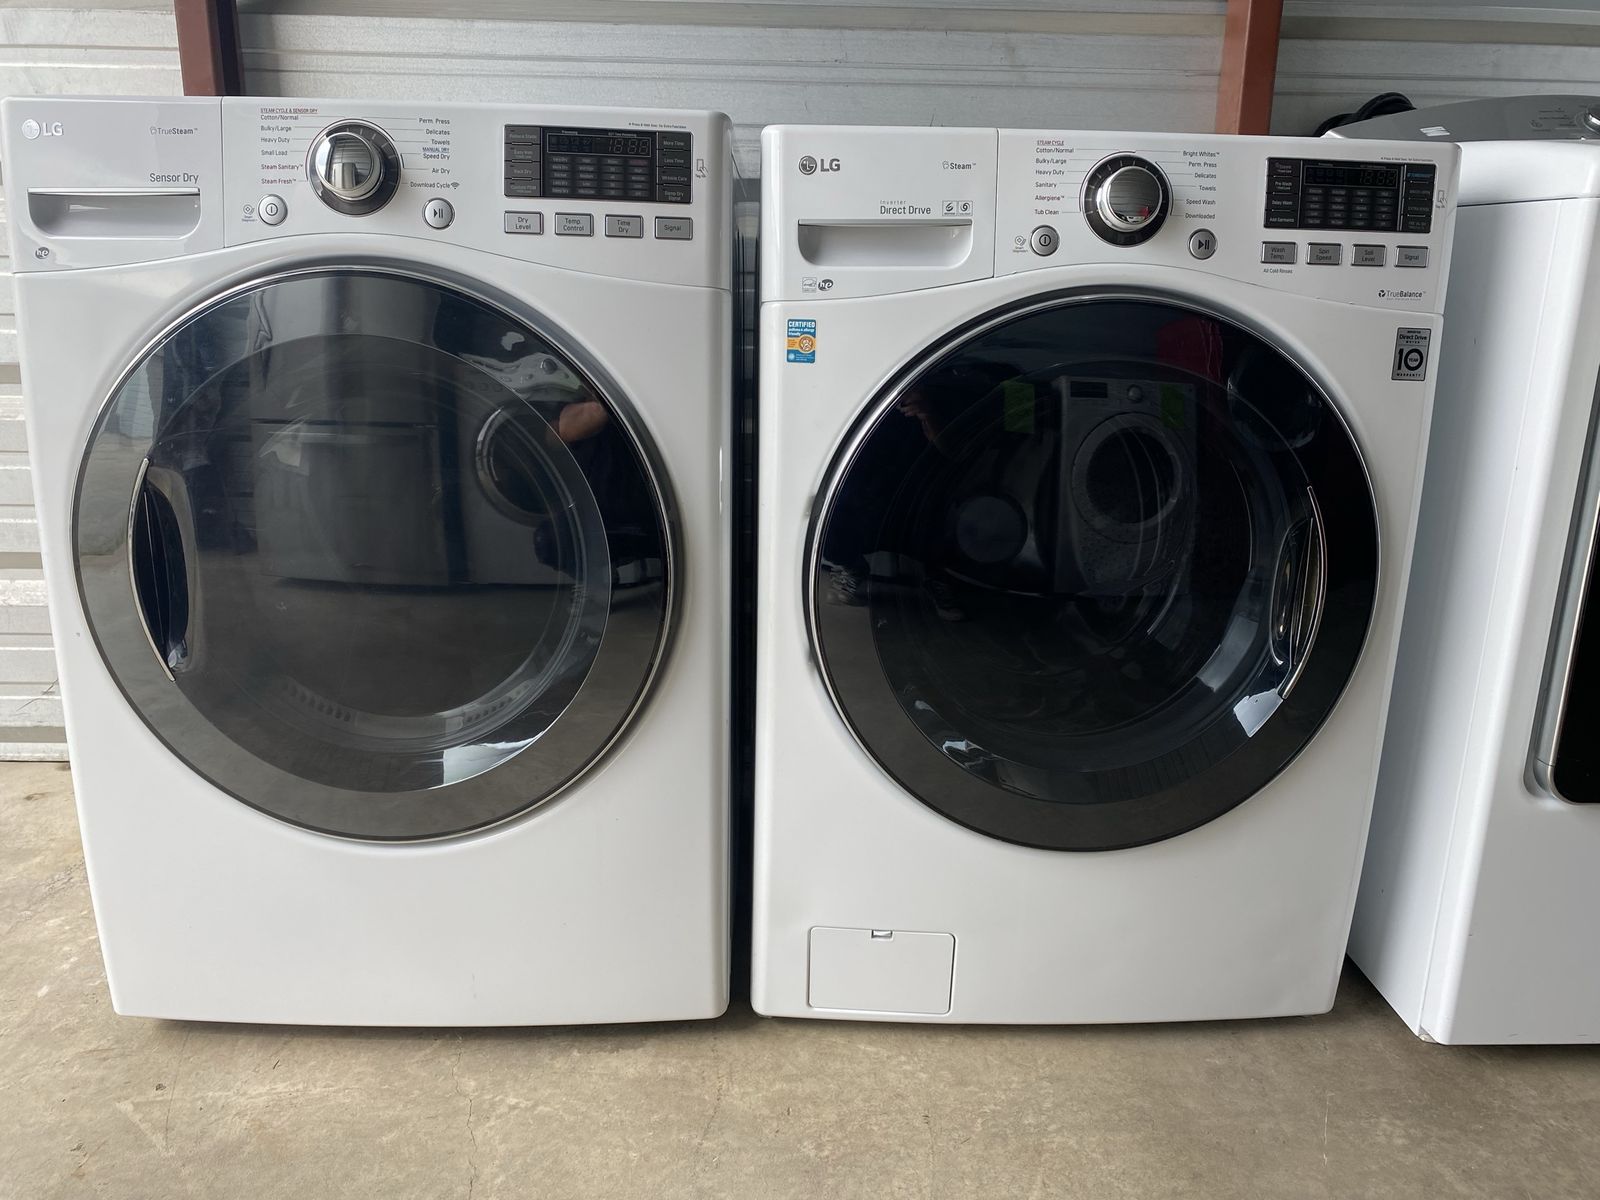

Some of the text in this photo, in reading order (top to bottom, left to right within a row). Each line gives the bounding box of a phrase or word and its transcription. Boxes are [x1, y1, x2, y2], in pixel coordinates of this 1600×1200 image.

[42, 122, 64, 136] LG
[820, 158, 841, 172] LG
[150, 172, 199, 184] Sensor Dry
[880, 205, 931, 215] Direct Drive
[619, 226, 629, 234] Dry
[664, 224, 681, 232] Signal
